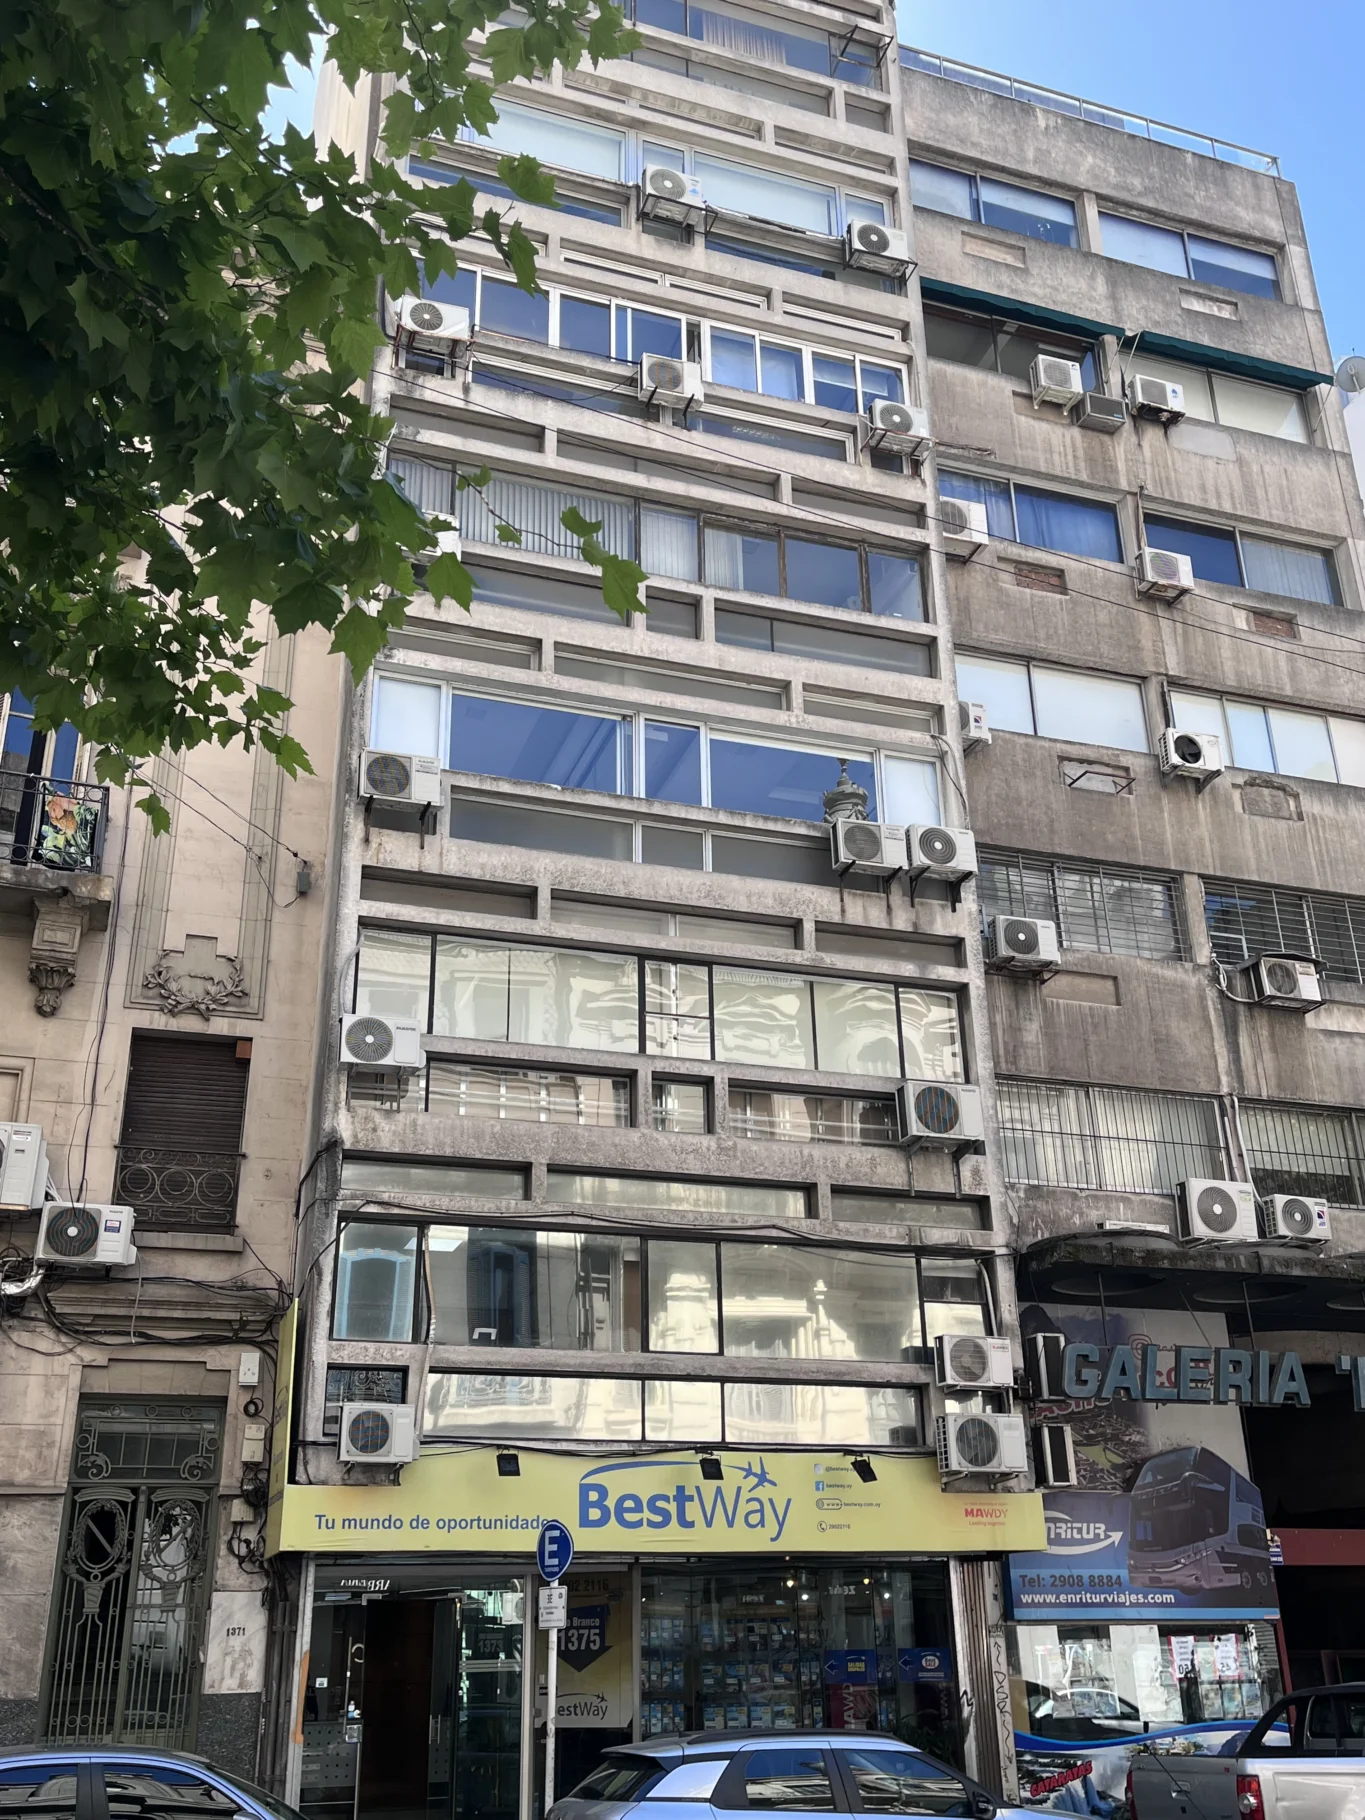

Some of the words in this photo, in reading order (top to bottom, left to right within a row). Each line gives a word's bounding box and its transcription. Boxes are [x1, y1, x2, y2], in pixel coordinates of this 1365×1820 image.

[1064, 1343, 1311, 1406] GALERIA
[578, 1483, 792, 1543] BestWay
[964, 1508, 1008, 1518] MAWDY
[315, 1515, 335, 1530] Tu
[342, 1515, 403, 1530] mundo
[409, 1515, 430, 1530] de
[436, 1515, 558, 1533] oportunidad
[544, 1530, 560, 1566] E
[1019, 1575, 1045, 1588] Tel:
[1050, 1575, 1084, 1587] 2908
[1088, 1575, 1123, 1587] 8884
[1020, 1591, 1175, 1606] www.enriturviajes.com
[572, 1616, 600, 1627] Branco
[226, 1626, 246, 1637] 1371
[558, 1629, 600, 1651] 1375
[557, 1701, 608, 1721] estWay
[1030, 1760, 1093, 1798] CATARATAS
